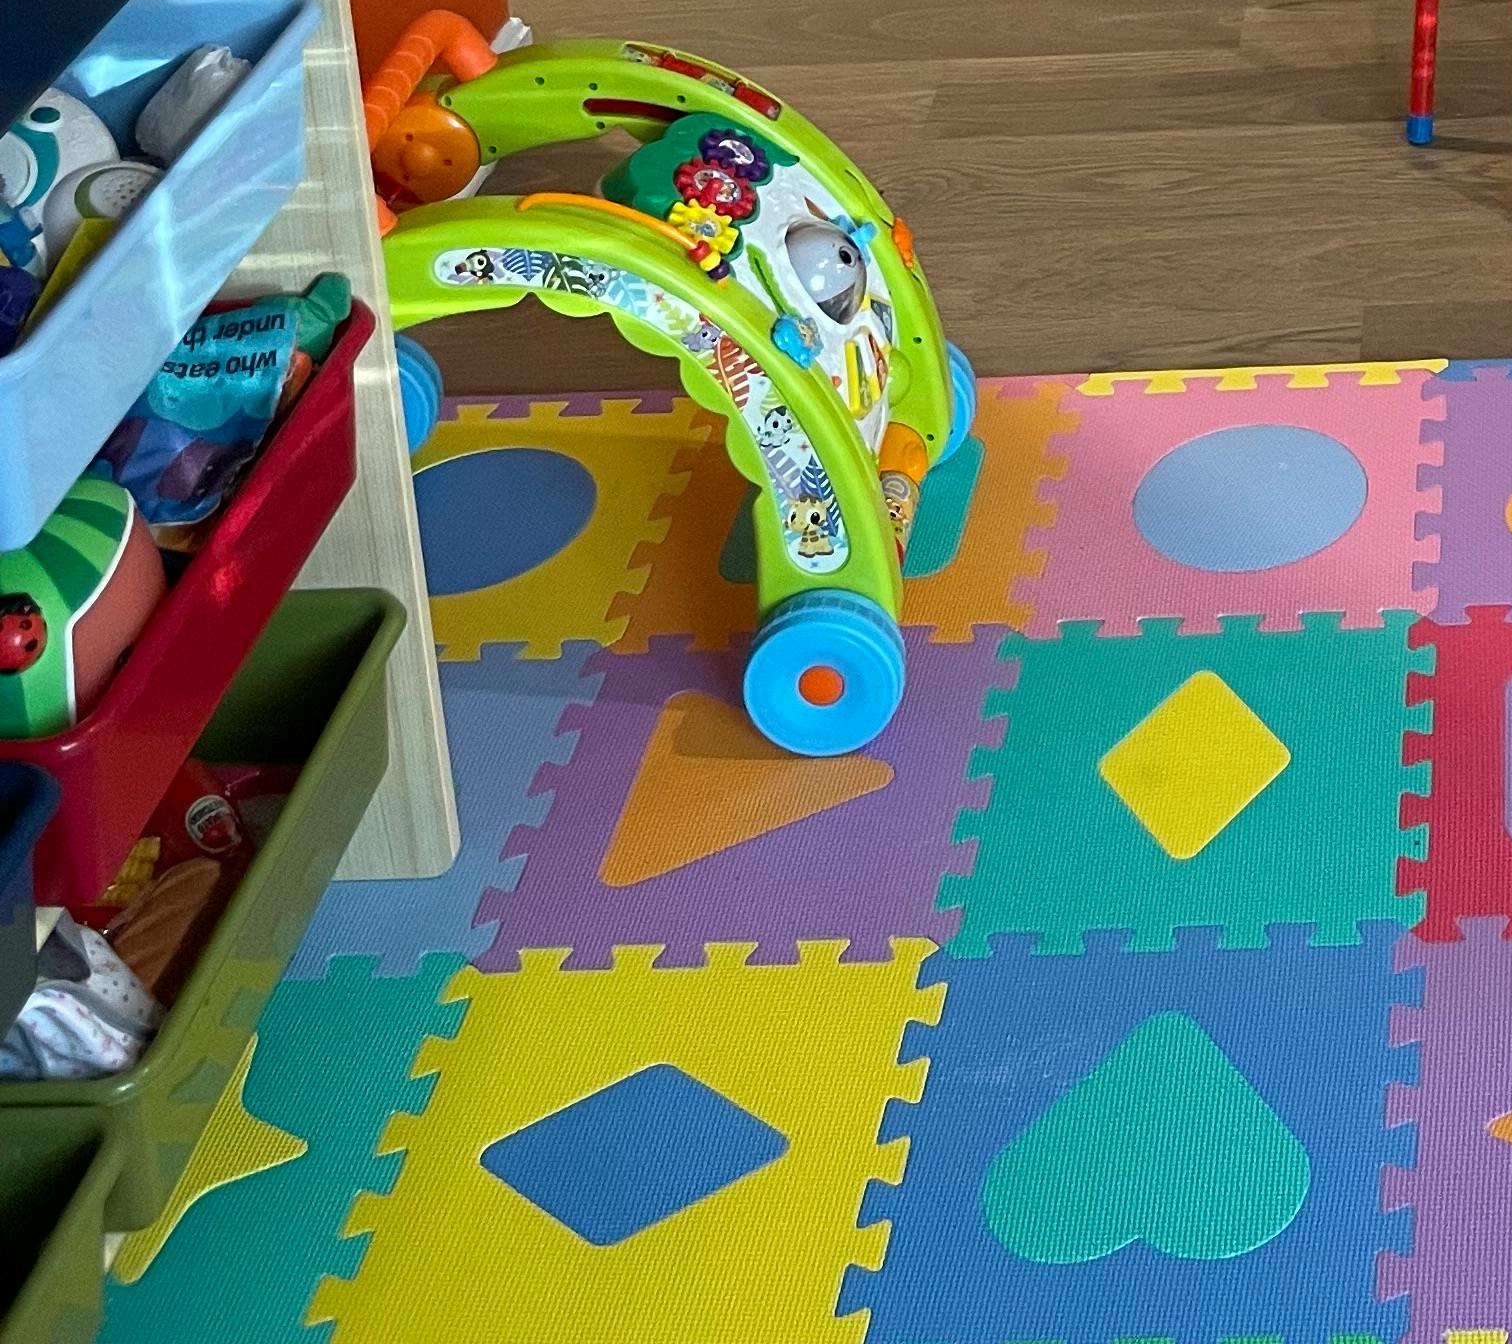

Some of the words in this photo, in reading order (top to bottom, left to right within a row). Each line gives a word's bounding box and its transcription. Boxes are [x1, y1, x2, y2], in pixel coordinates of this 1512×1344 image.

[181, 323, 207, 353] th
[212, 313, 286, 342] under
[160, 361, 220, 381] eats
[225, 349, 277, 378] who
